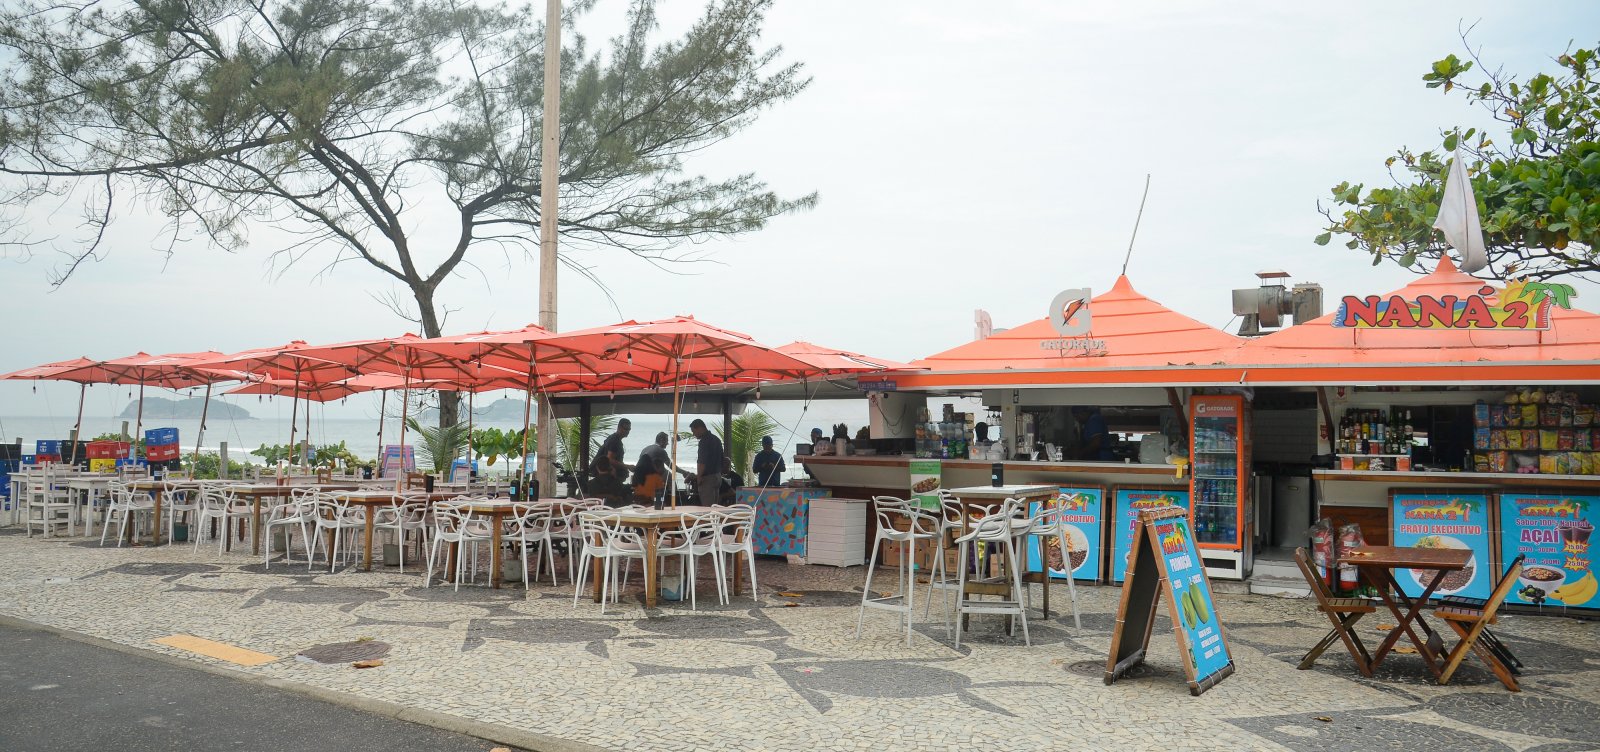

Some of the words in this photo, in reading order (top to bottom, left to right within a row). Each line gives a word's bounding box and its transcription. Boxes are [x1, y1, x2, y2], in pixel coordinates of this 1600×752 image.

[1049, 288, 1091, 336] G
[1342, 286, 1498, 328] NANÁ
[1501, 301, 1529, 328] 2
[1040, 340, 1106, 350] GATORADE
[1405, 508, 1444, 520] NANÁ
[1446, 510, 1457, 520] 2
[1520, 507, 1556, 517] NANÁ
[1557, 508, 1568, 518] 2
[1060, 514, 1095, 523] XECUTIVO
[1516, 518, 1537, 526] Sabor
[1540, 519, 1559, 528] 100%
[1400, 524, 1429, 534] PRATO
[1431, 525, 1482, 535] EXECUTIVO
[1520, 527, 1560, 546] AÇAÍ
